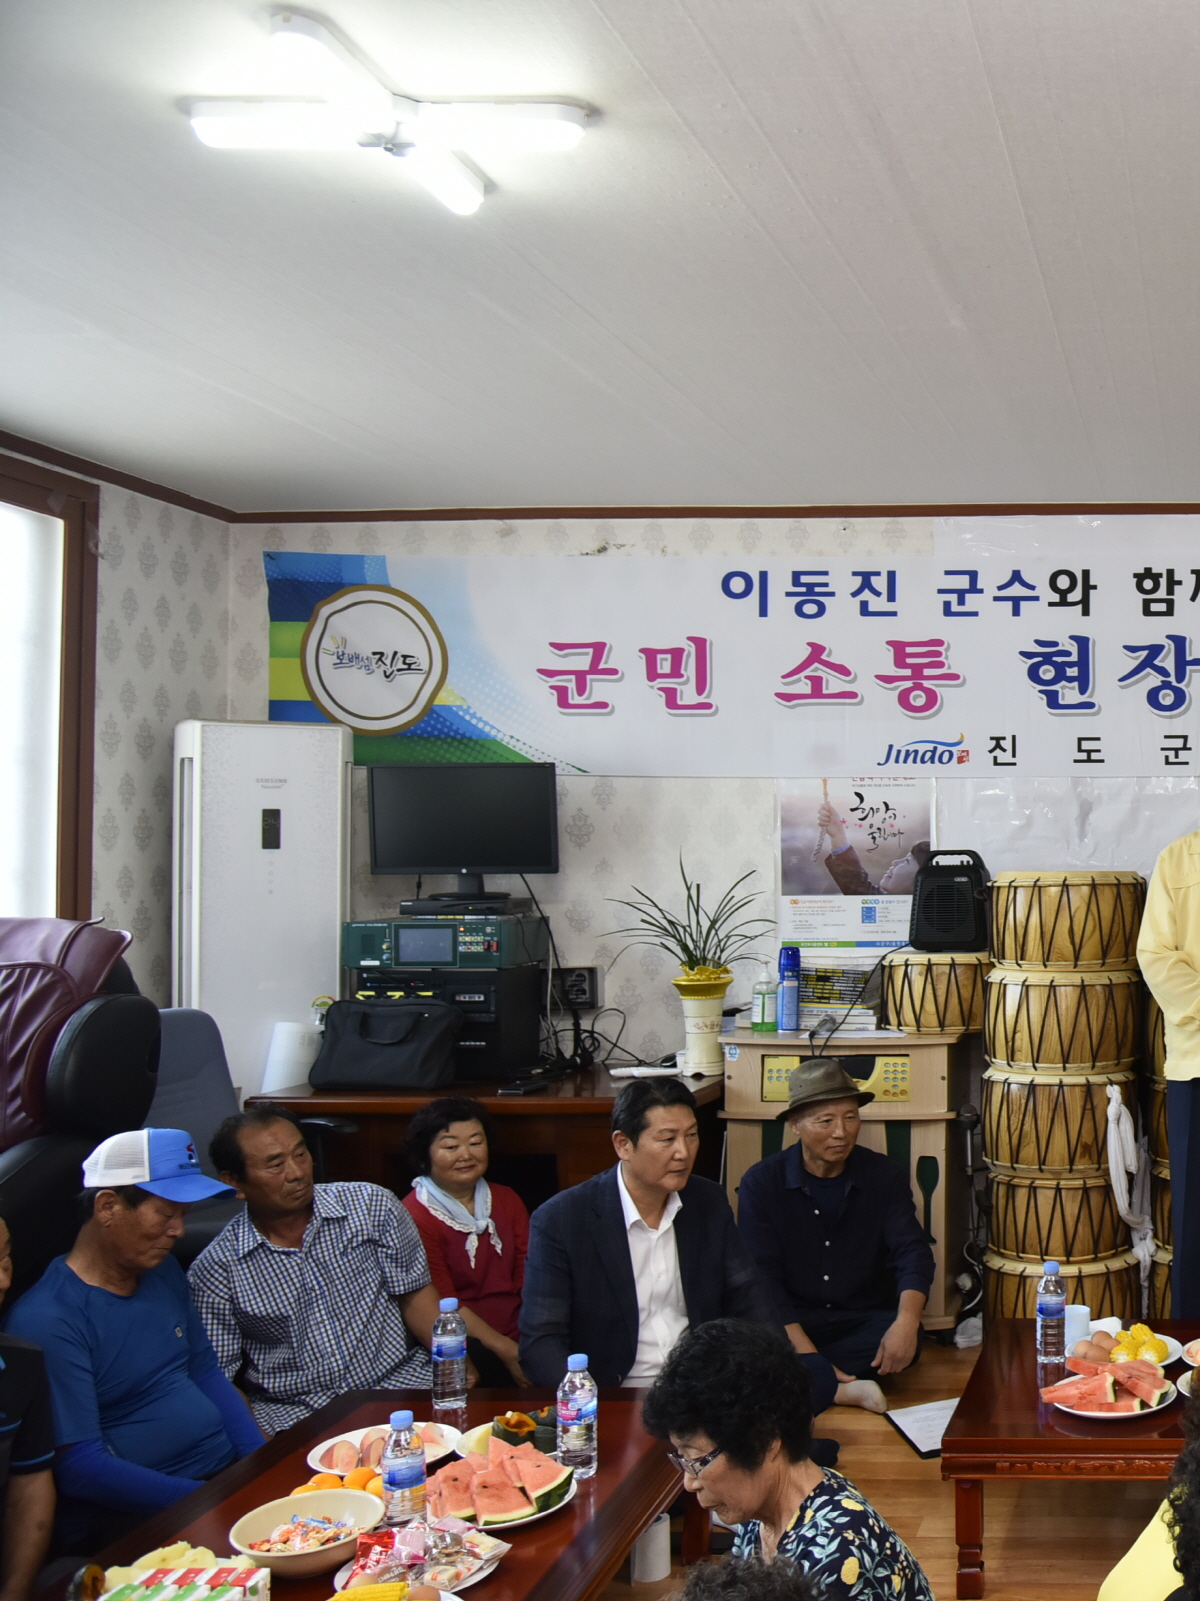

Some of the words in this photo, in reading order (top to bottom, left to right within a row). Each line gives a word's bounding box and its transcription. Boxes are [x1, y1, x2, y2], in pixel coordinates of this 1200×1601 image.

[721, 570, 898, 619] 이동진
[936, 568, 1098, 618] 군수와
[333, 650, 371, 672] 보배섬
[372, 651, 424, 679] 진도
[536, 636, 714, 711] 군민
[774, 638, 962, 714] 소통
[877, 744, 954, 766] Jindo
